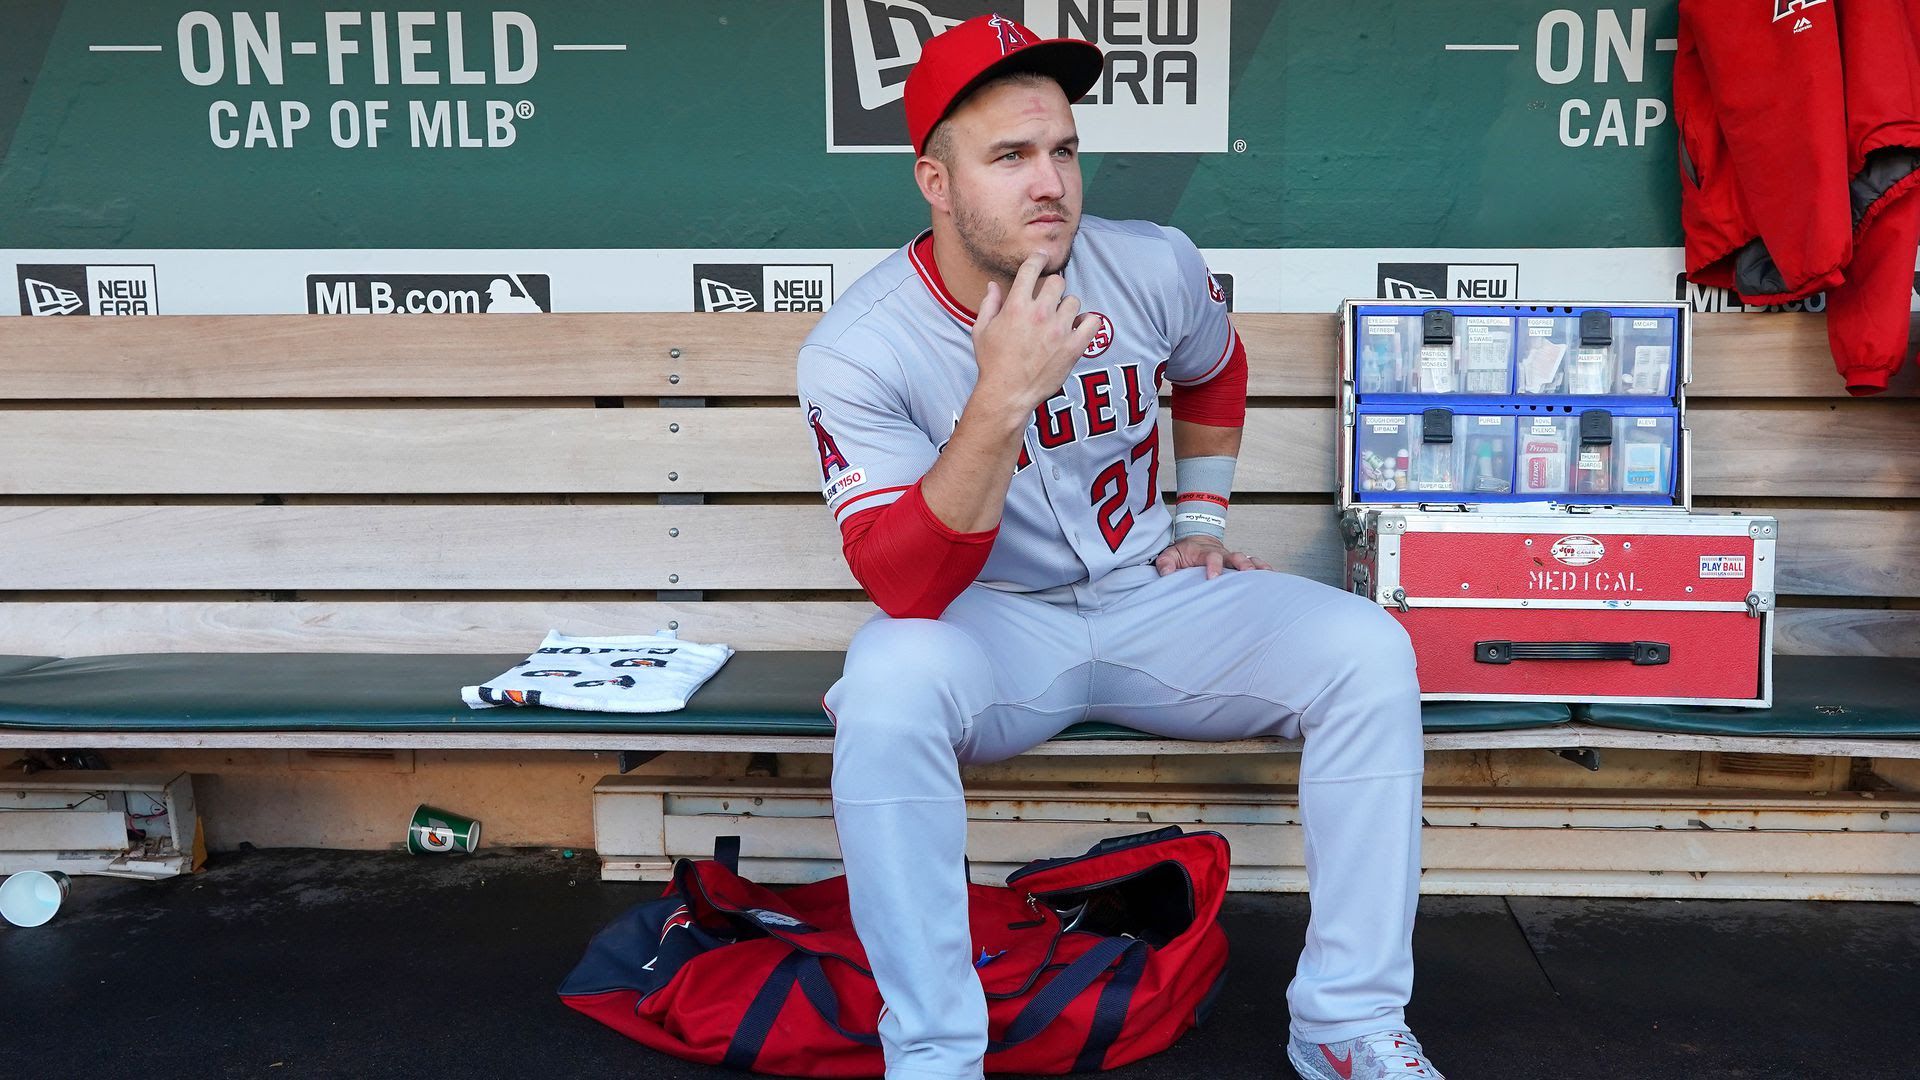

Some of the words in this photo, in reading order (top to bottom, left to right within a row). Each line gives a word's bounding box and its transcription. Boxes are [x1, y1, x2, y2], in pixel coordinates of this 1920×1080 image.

[1058, 0, 1198, 45] NEW
[177, 11, 539, 86] ON-FIELD
[1070, 50, 1198, 105] RA
[209, 101, 310, 148] CAP
[330, 101, 389, 148] OF
[1559, 98, 1667, 147] CAP
[98, 280, 147, 299] NEW
[315, 282, 480, 314] MLB.com
[774, 280, 823, 299] NEW
[1457, 279, 1507, 299] NEW
[1091, 419, 1160, 554] 27
[1529, 571, 1643, 591] MEDICAL
[1701, 562, 1721, 571] PLAY
[1723, 562, 1743, 571] BALL
